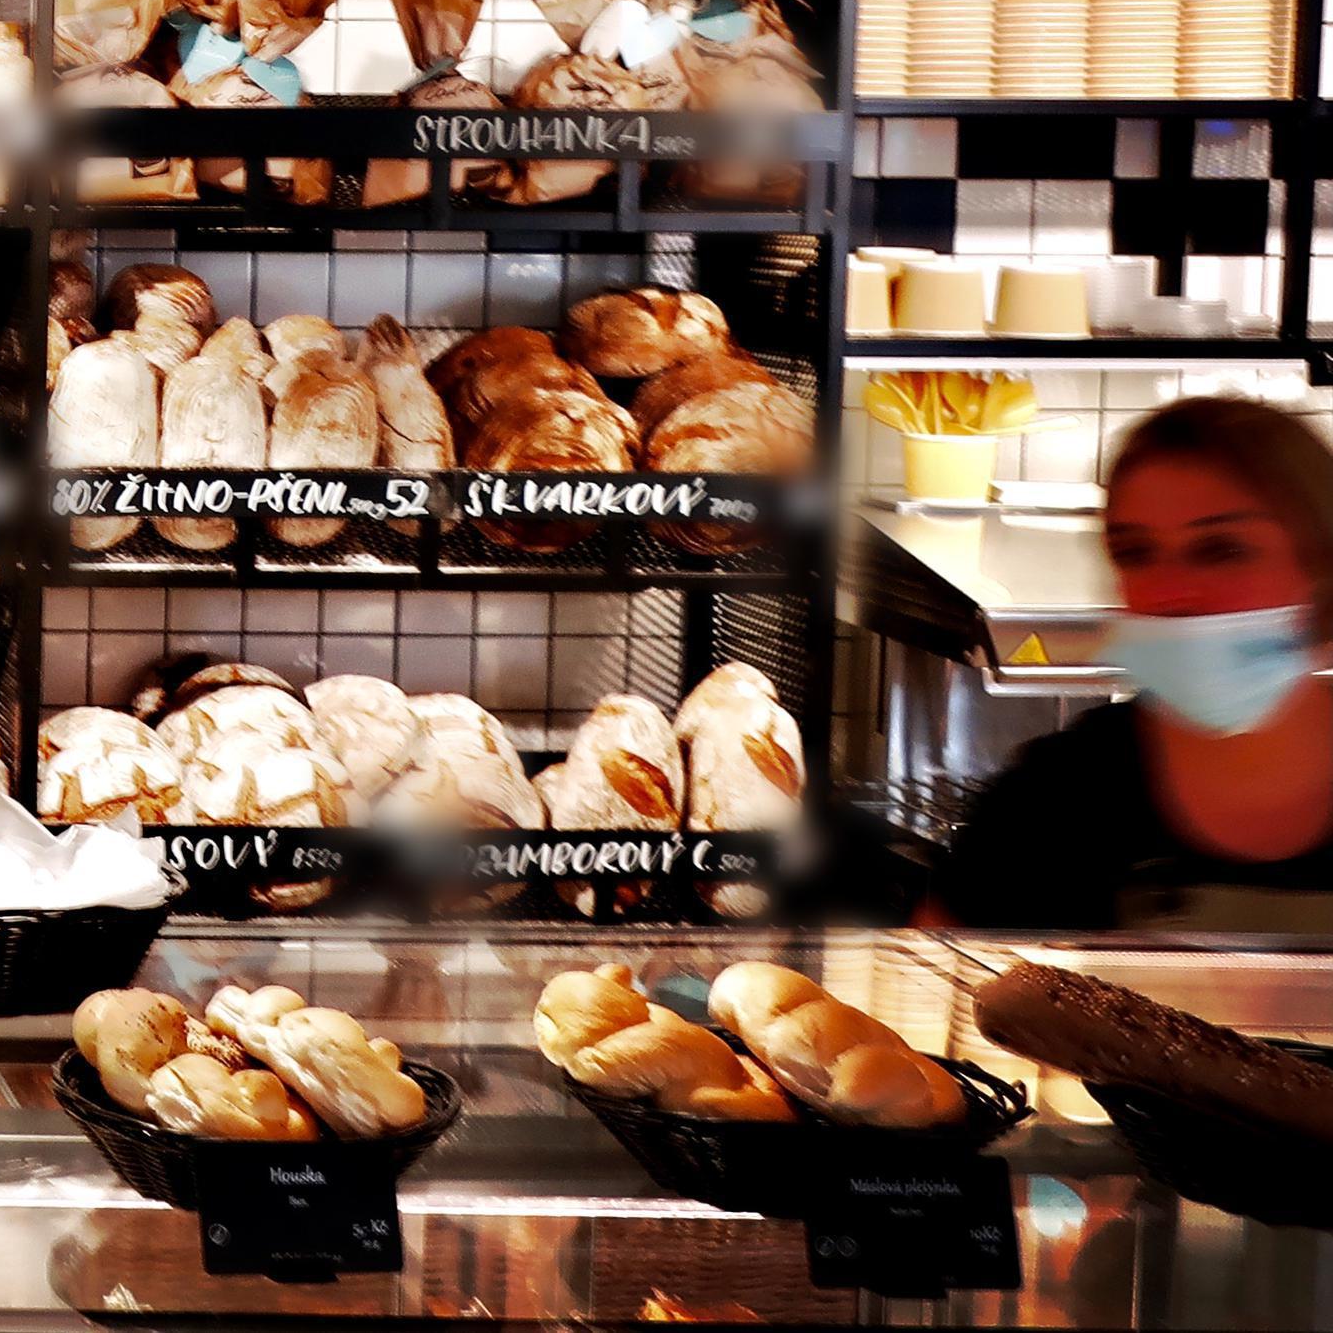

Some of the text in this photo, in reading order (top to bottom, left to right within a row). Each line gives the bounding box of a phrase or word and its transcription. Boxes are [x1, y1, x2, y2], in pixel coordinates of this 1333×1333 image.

[413, 114, 652, 154] STROUHANKA
[386, 478, 430, 518] 52
[464, 472, 708, 518] ŠKVARKOVÝ
[269, 1164, 327, 1185] Houska
